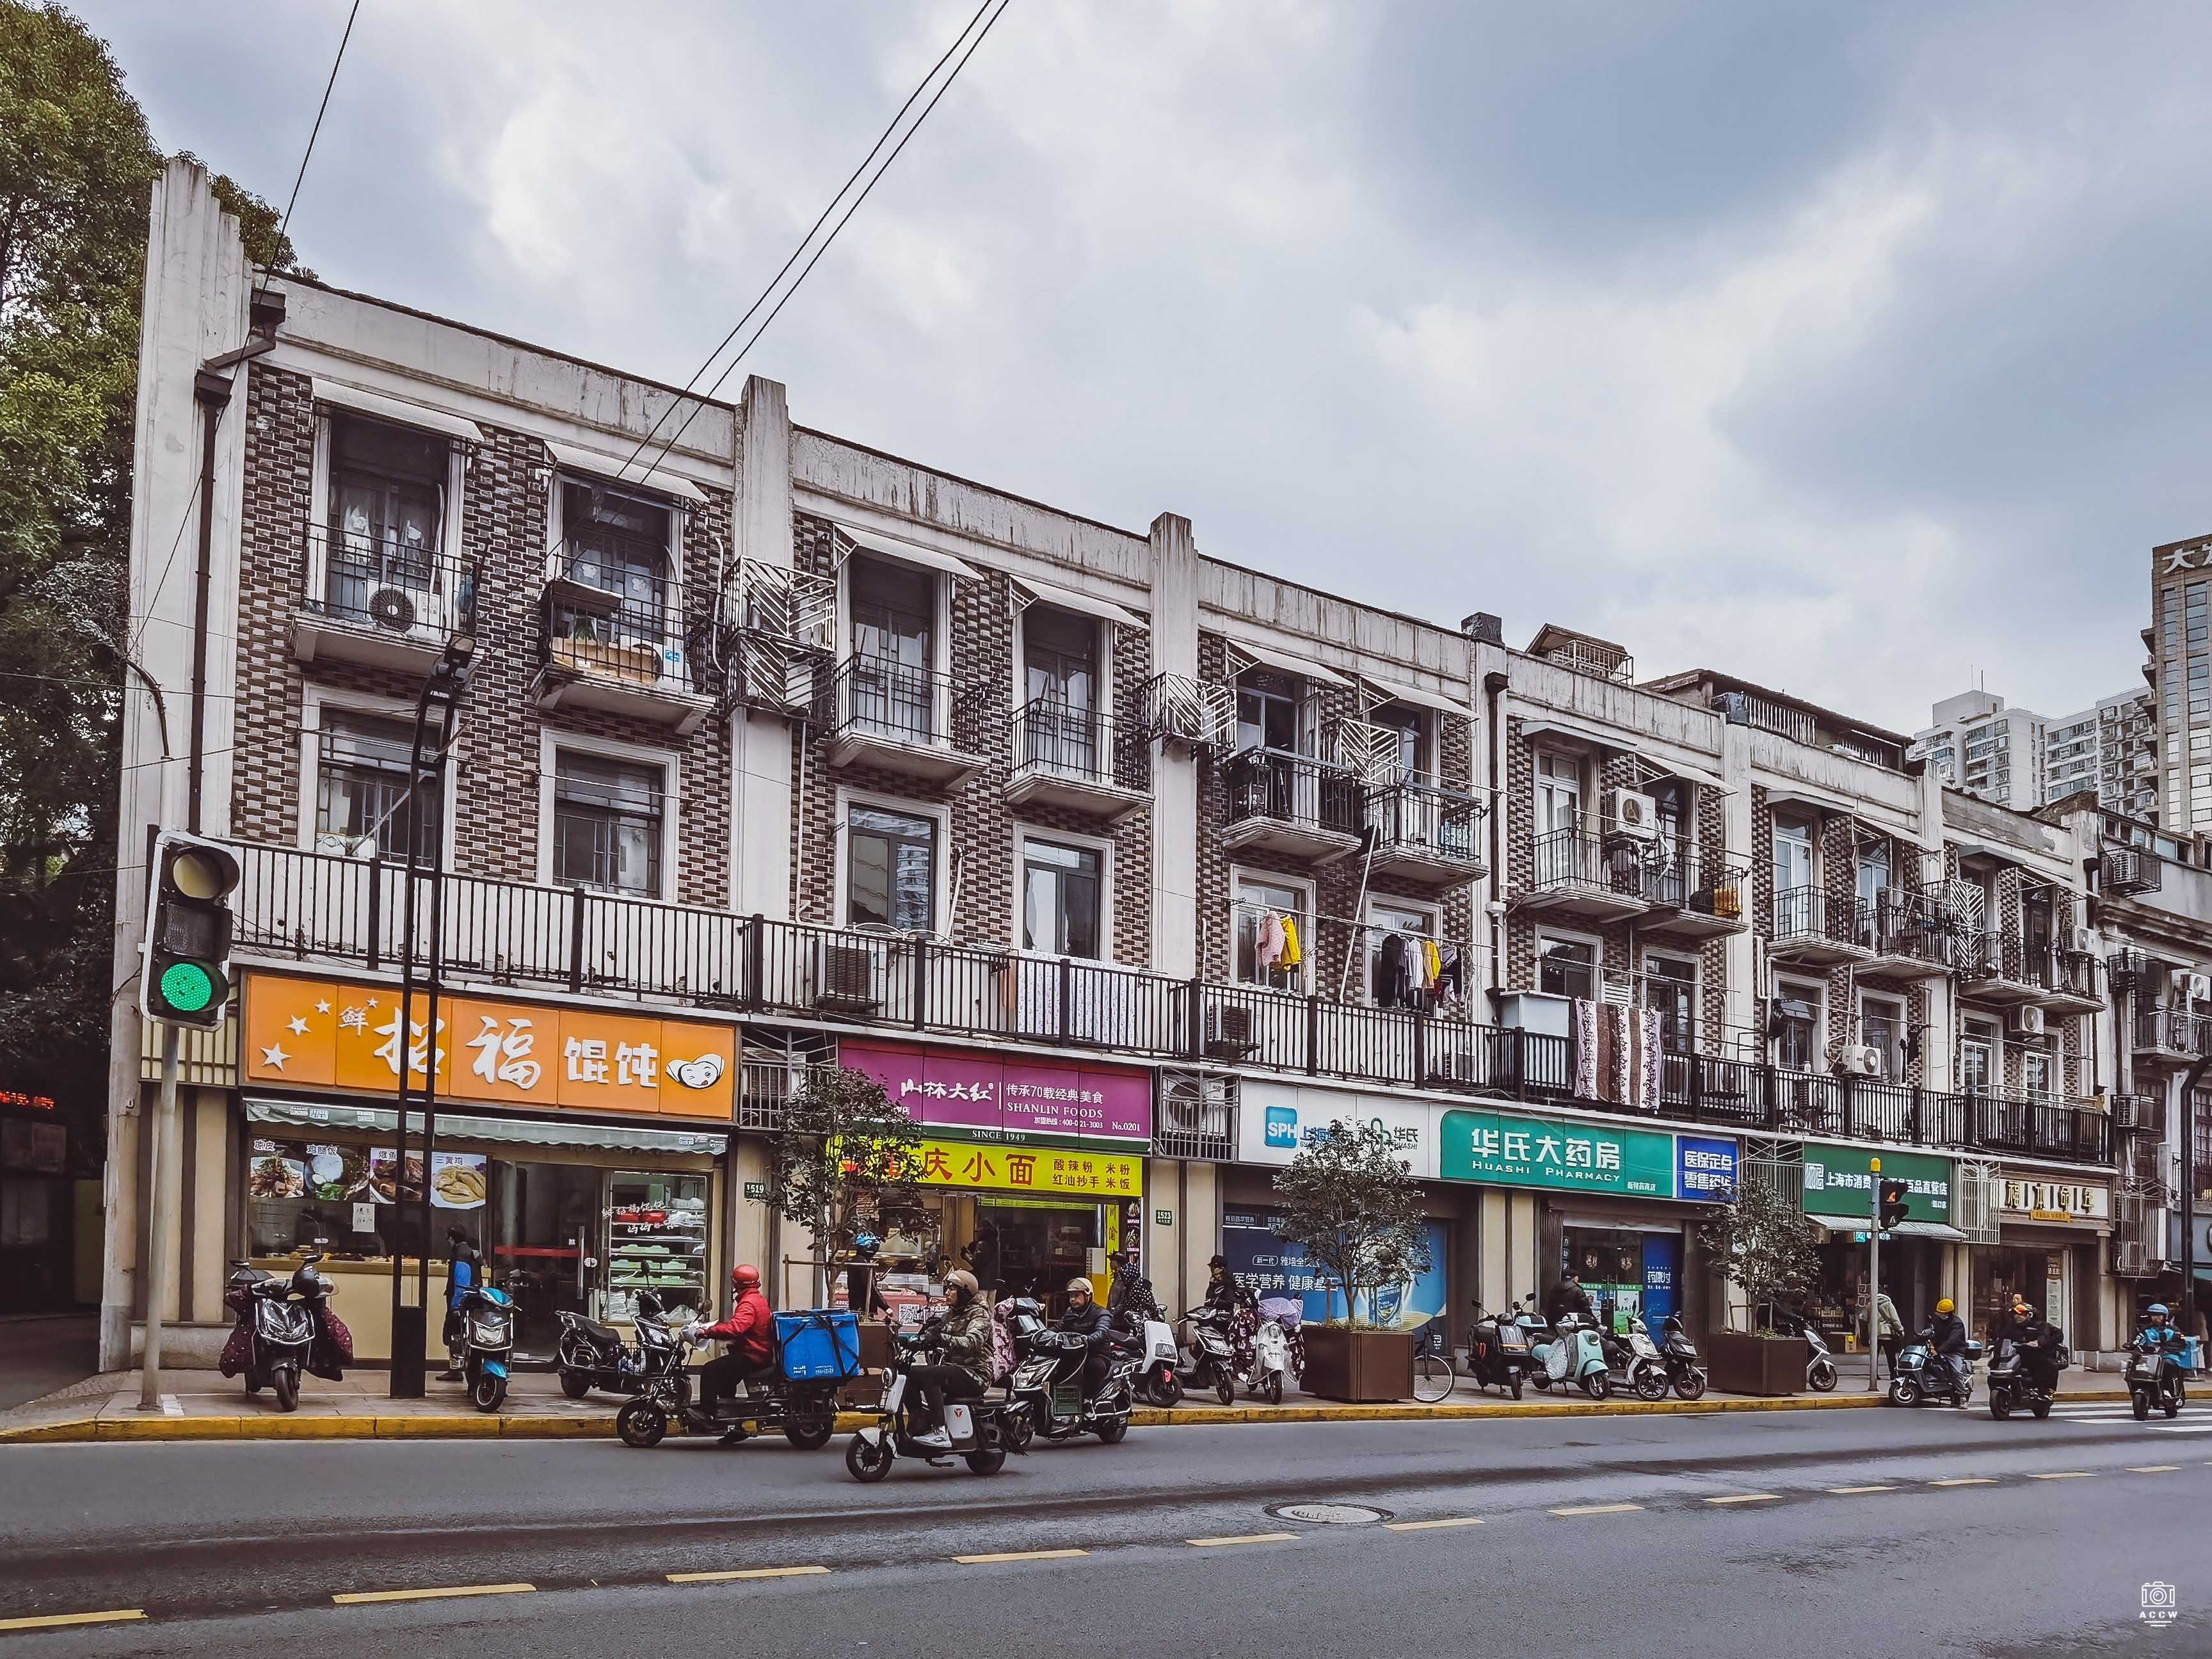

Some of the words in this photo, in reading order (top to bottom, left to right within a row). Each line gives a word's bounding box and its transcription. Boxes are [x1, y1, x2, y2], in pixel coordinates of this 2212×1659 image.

[901, 1078, 993, 1102] 山林大红
[1006, 1083, 1104, 1105] 传承70载经典美食
[1007, 1102, 1059, 1114] SHANLIN
[1064, 1107, 1103, 1119] FOODS
[1111, 1121, 1141, 1132] No.0201
[1267, 1121, 1297, 1139] SPH
[1393, 1126, 1418, 1143] 华氏
[972, 1130, 1002, 1140] SINCE
[1006, 1132, 1025, 1142] 1949
[1471, 1128, 1621, 1170] 华氏大药房
[1053, 1158, 1093, 1173] 酸辣粉
[1105, 1162, 1130, 1176] 米粉
[1684, 1150, 1733, 1171] 医保定点
[1472, 1160, 1530, 1174] HUASHI
[1546, 1167, 1621, 1182] PHARMACY
[746, 1184, 764, 1194] 1519
[1052, 1173, 1100, 1189] 红油抄手
[1105, 1177, 1130, 1190] 米饭
[1157, 1211, 1171, 1220] 1523
[1233, 1272, 1285, 1290] 医学营养
